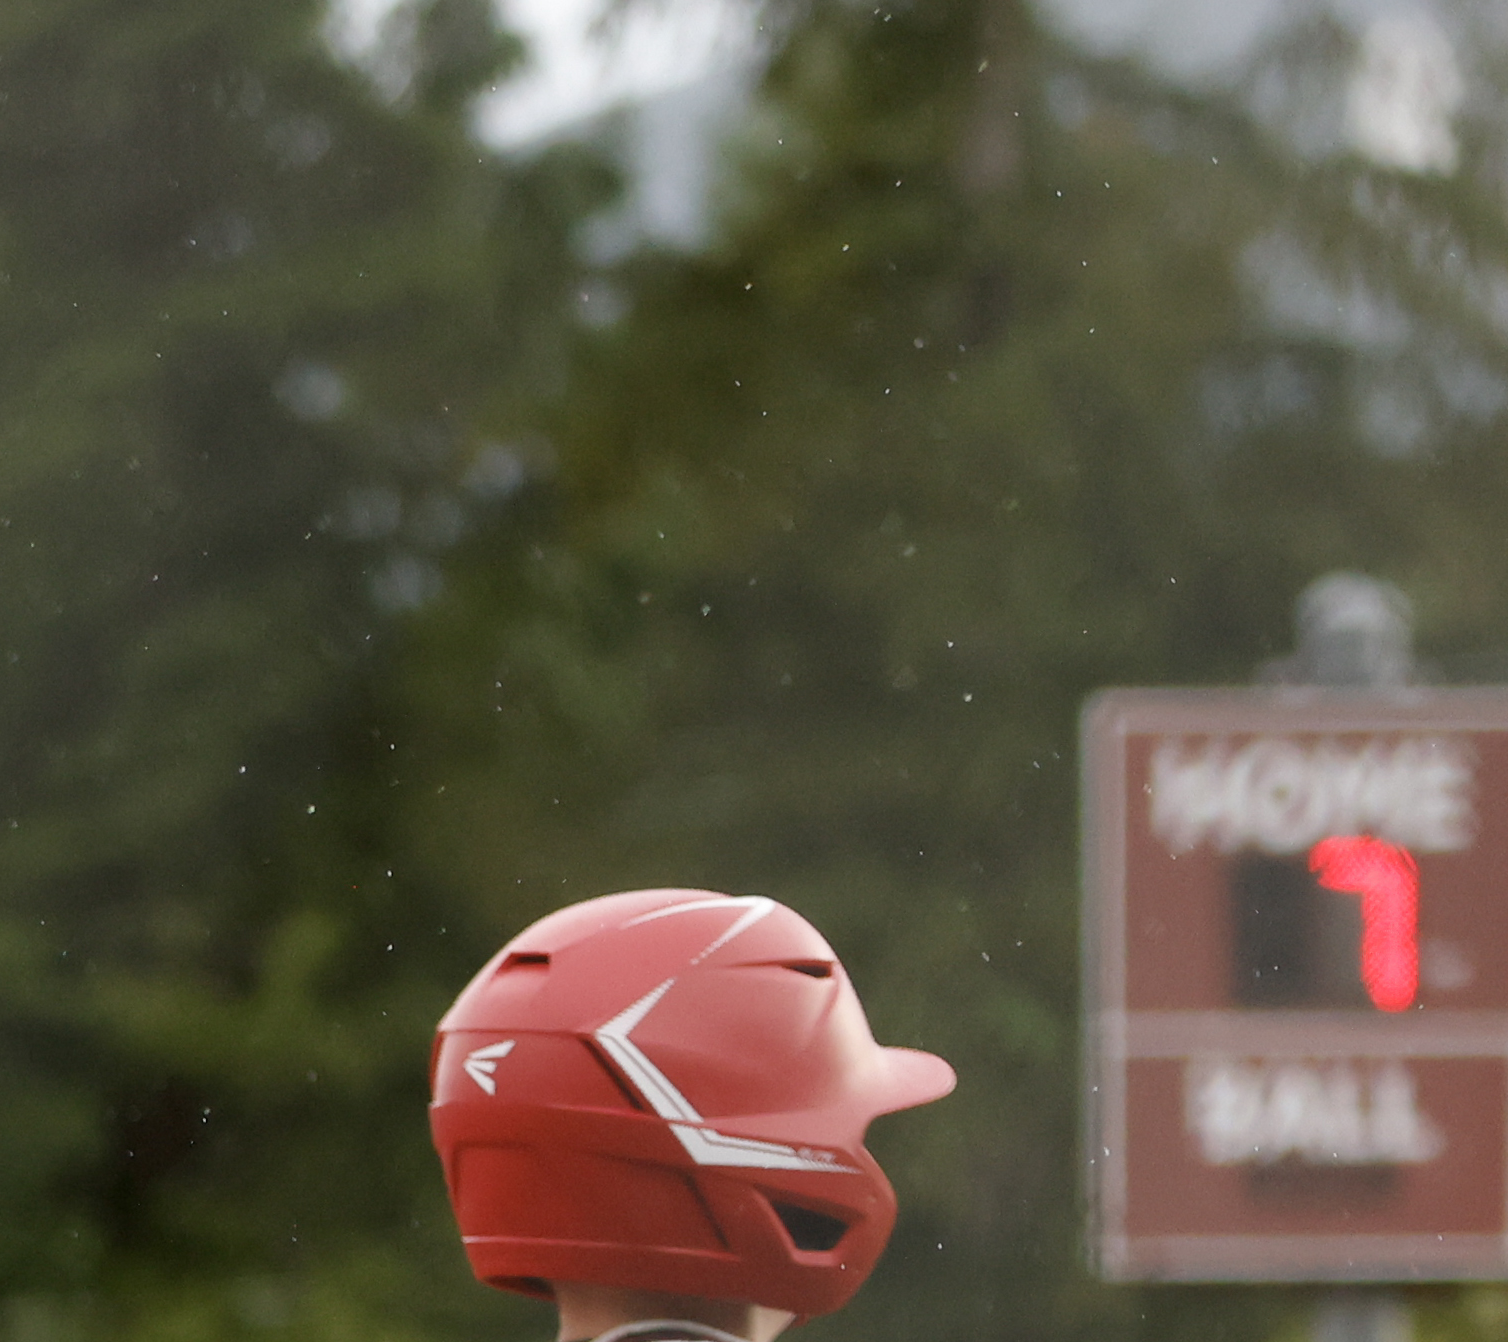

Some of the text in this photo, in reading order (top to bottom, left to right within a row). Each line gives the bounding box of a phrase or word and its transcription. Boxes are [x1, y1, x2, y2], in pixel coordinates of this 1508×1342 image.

[1152, 742, 1478, 855] HOME
[1309, 836, 1419, 1012] 7
[1189, 1062, 1445, 1165] BALL
